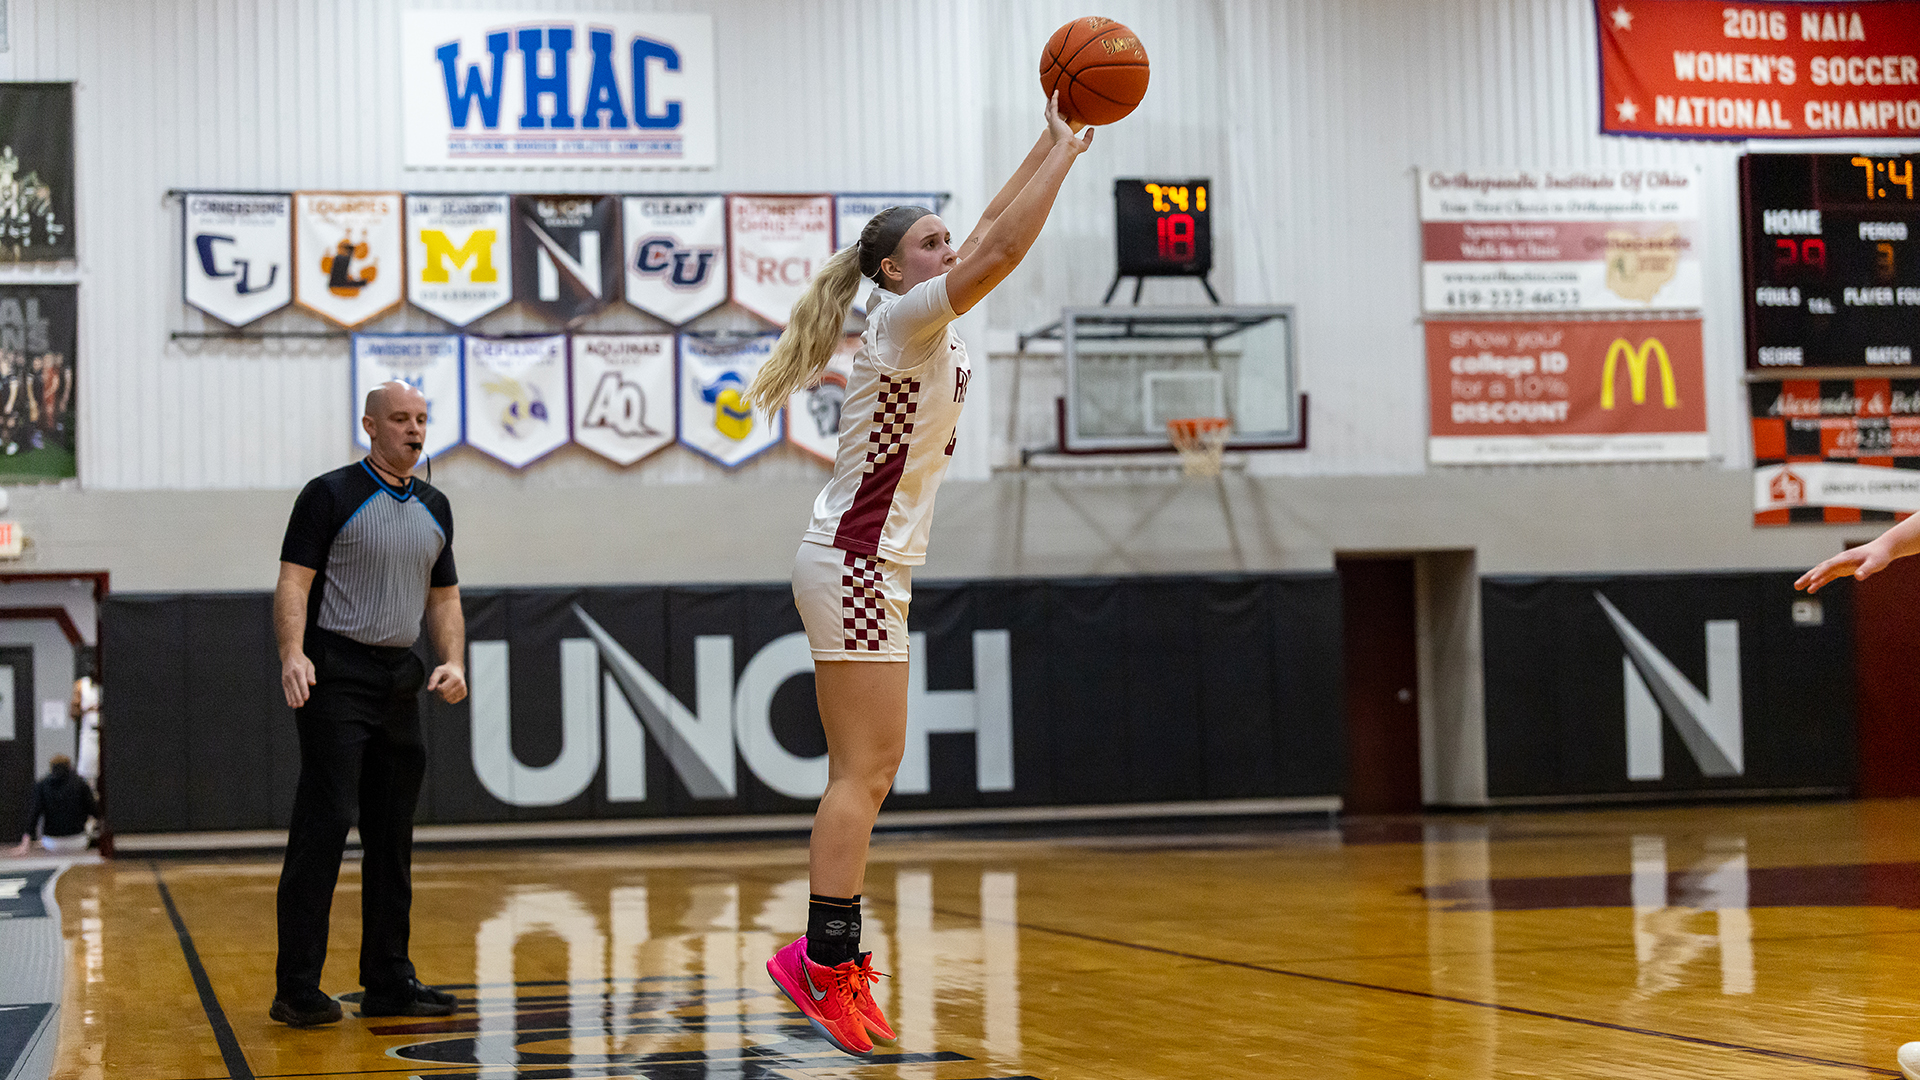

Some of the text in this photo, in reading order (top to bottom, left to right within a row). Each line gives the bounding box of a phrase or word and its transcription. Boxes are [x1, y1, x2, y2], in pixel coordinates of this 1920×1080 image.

[1722, 8, 1866, 42] 2016 NAIA
[433, 20, 683, 131] WHAC
[1673, 50, 1919, 86] WOMEN'S SOCCER
[1655, 95, 1793, 130] NATIONAL
[1145, 183, 1207, 213] 7:41
[1763, 209, 1822, 235] HOME
[1859, 221, 1908, 241] PERIOD
[1157, 213, 1195, 262] 18
[418, 229, 499, 284] M
[636, 240, 714, 287] CU
[1756, 287, 1800, 307] FOULS
[1844, 287, 1895, 307] PLAYER
[1450, 331, 1564, 351] show your
[1450, 351, 1569, 379] college ID
[1758, 346, 1803, 367] SCORE
[1865, 346, 1912, 366] MATCH
[1451, 378, 1482, 397] for
[1450, 400, 1571, 425] DISCOUNT
[1593, 588, 1745, 782] N
